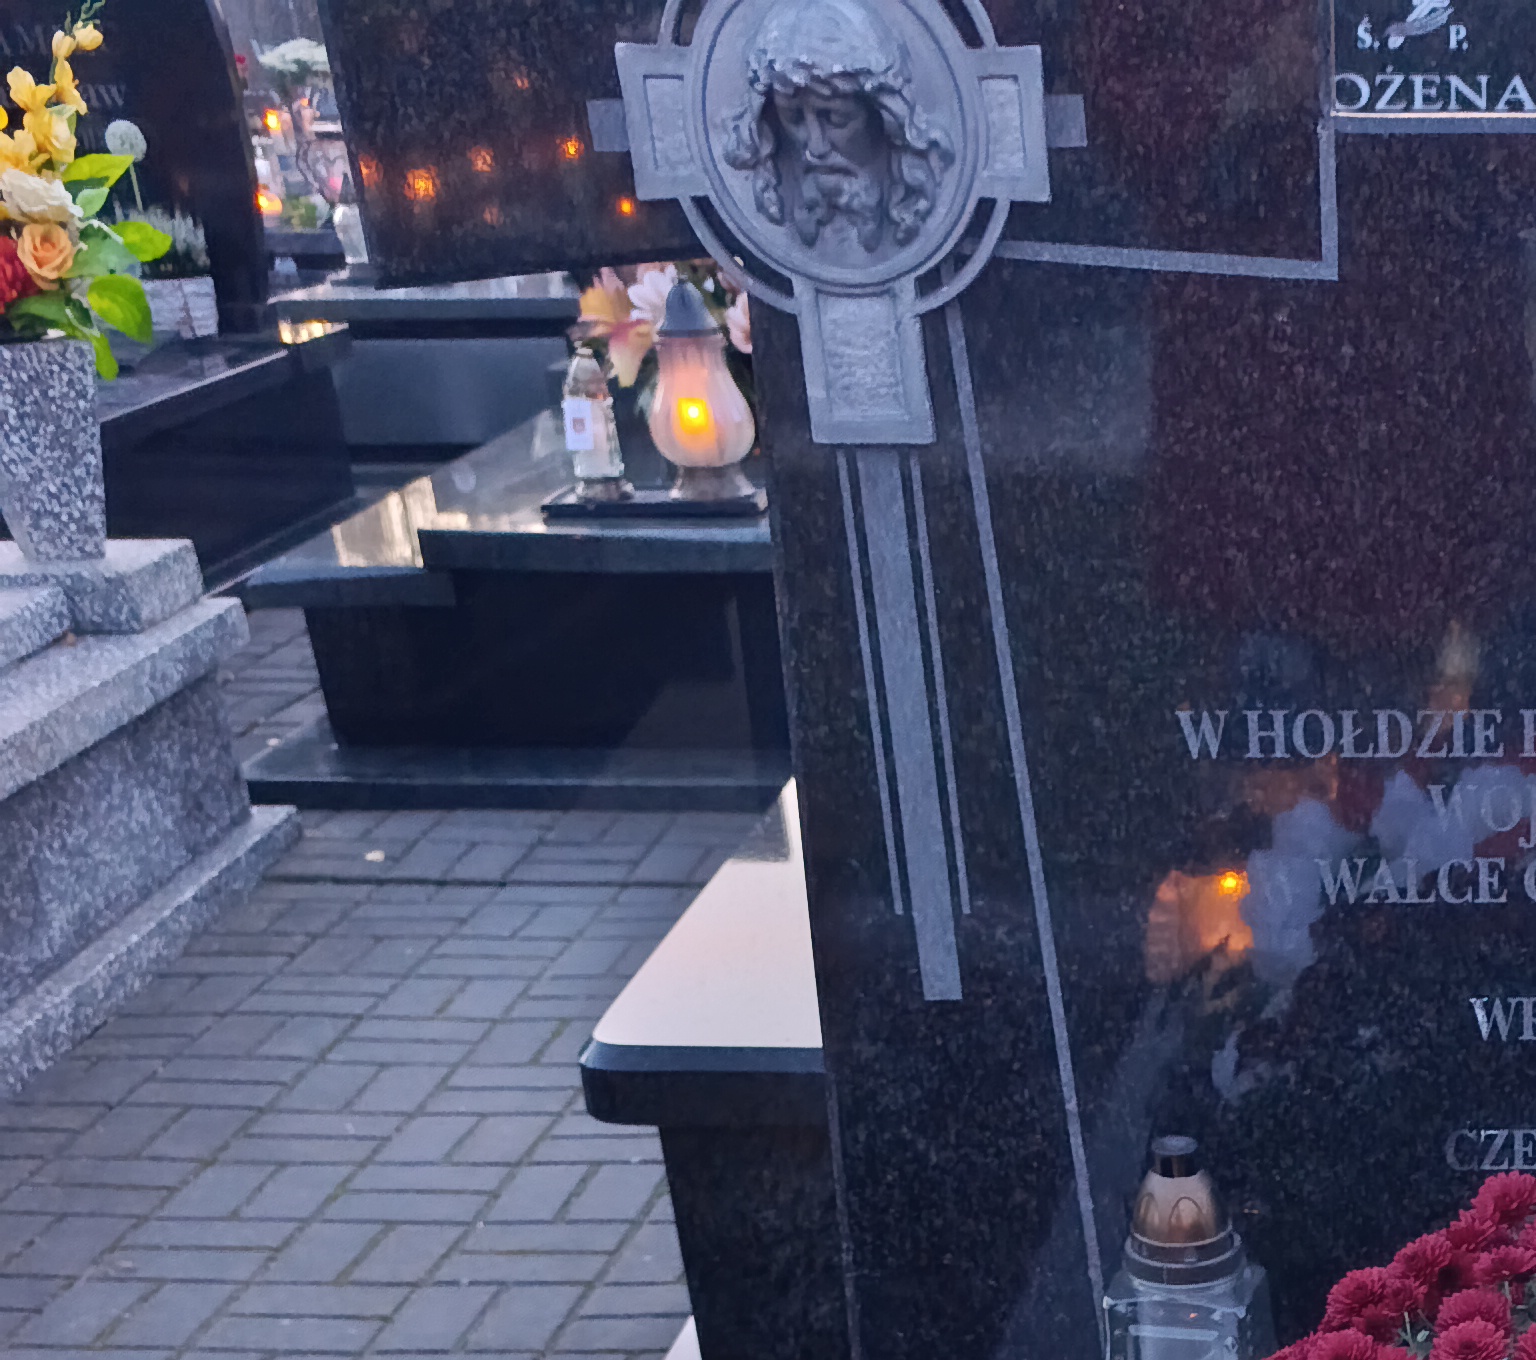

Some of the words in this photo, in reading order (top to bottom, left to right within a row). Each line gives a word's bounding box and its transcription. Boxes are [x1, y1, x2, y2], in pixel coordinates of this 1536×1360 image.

[1175, 709, 1229, 760] W
[1242, 708, 1502, 760] HOŁDZIE
[1314, 857, 1508, 905] WALCE
